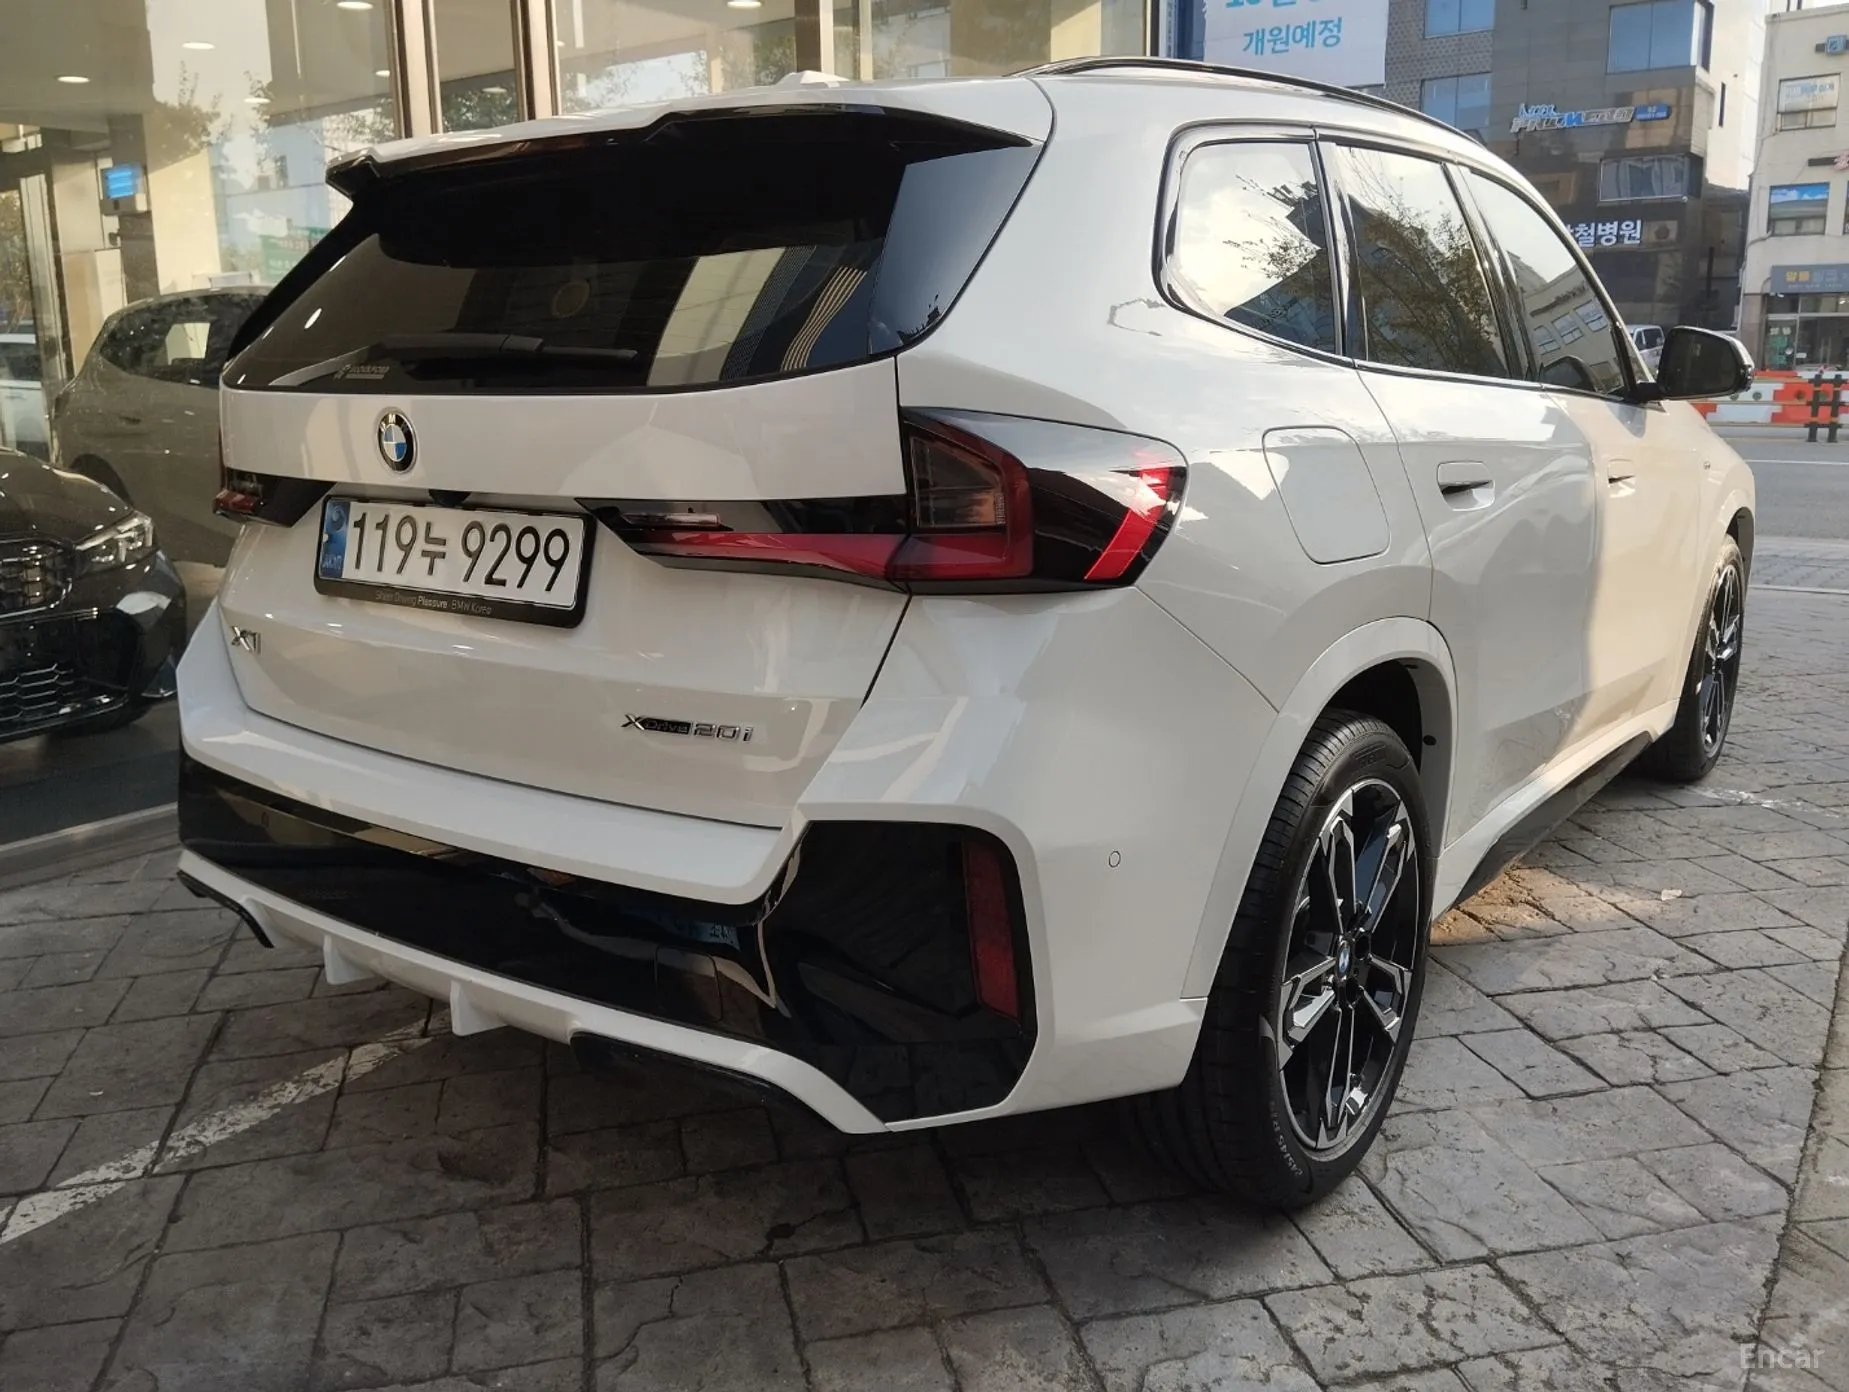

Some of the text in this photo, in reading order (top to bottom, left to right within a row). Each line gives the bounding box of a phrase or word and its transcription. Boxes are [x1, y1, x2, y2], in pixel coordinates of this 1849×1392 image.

[1243, 17, 1342, 56] 개원예정
[353, 511, 570, 592] 119누 9299
[451, 599, 471, 611] BMW
[470, 601, 493, 615] Korea
[231, 625, 261, 655] X1
